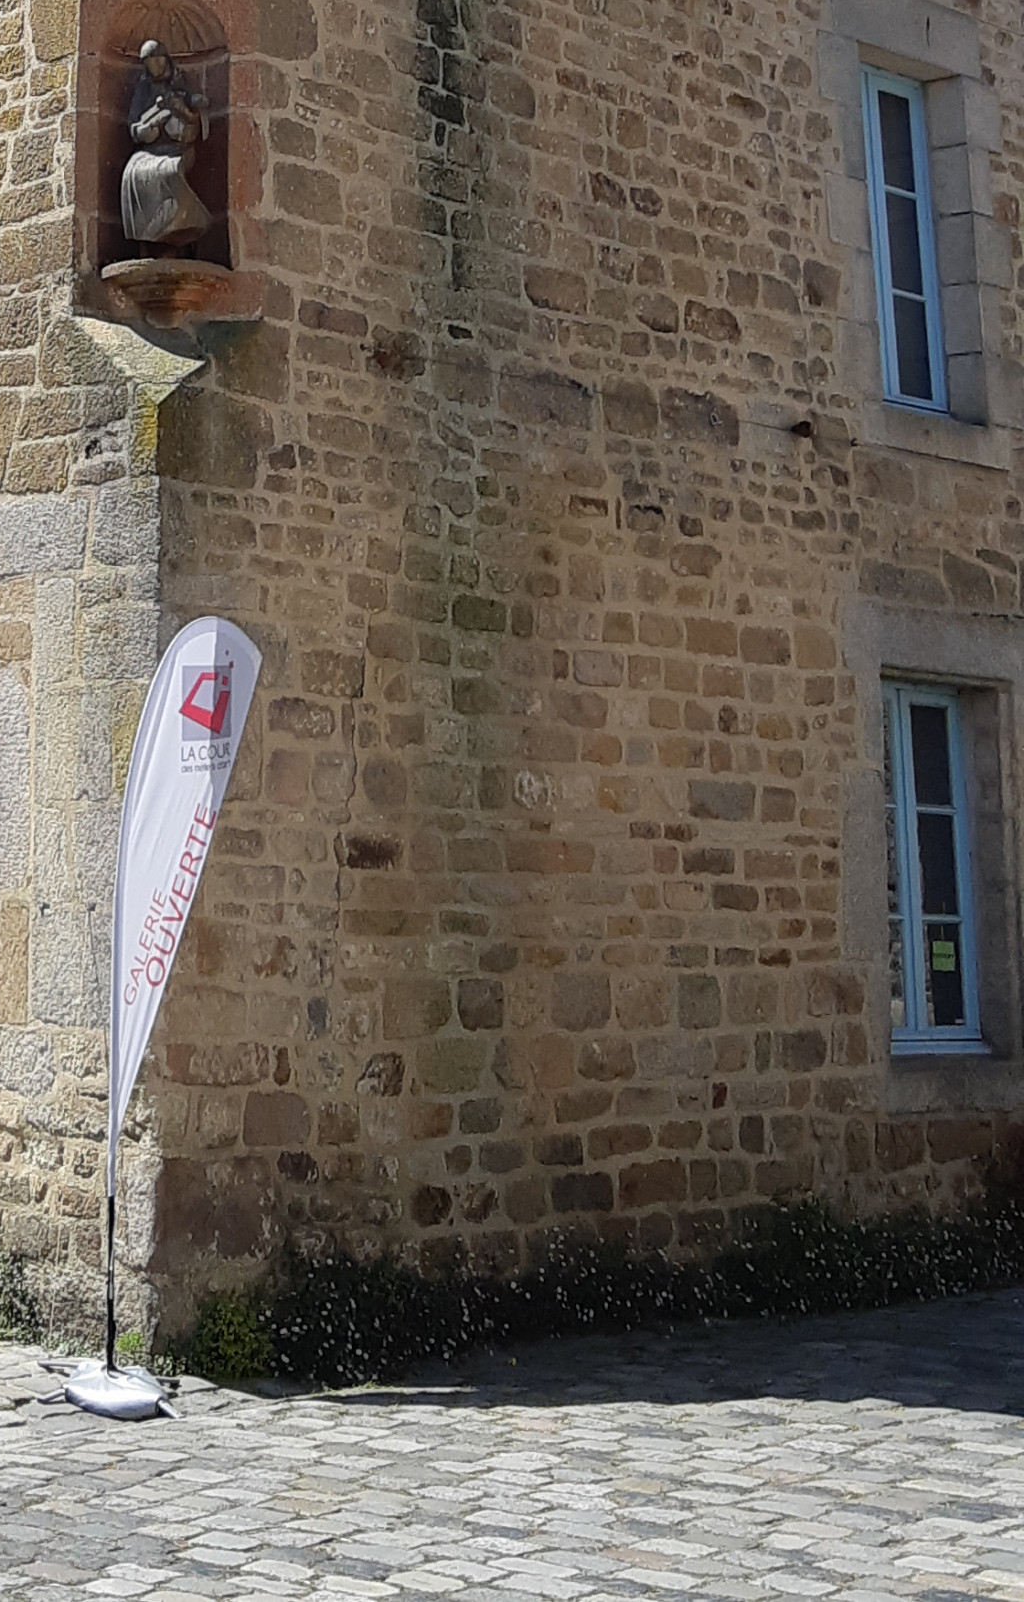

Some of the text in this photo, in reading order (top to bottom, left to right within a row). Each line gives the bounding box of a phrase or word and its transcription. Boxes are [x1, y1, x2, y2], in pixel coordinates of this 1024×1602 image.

[180, 742, 231, 762] LA COUR
[123, 887, 168, 1006] GALERIE
[145, 802, 217, 987] OUVERTE
